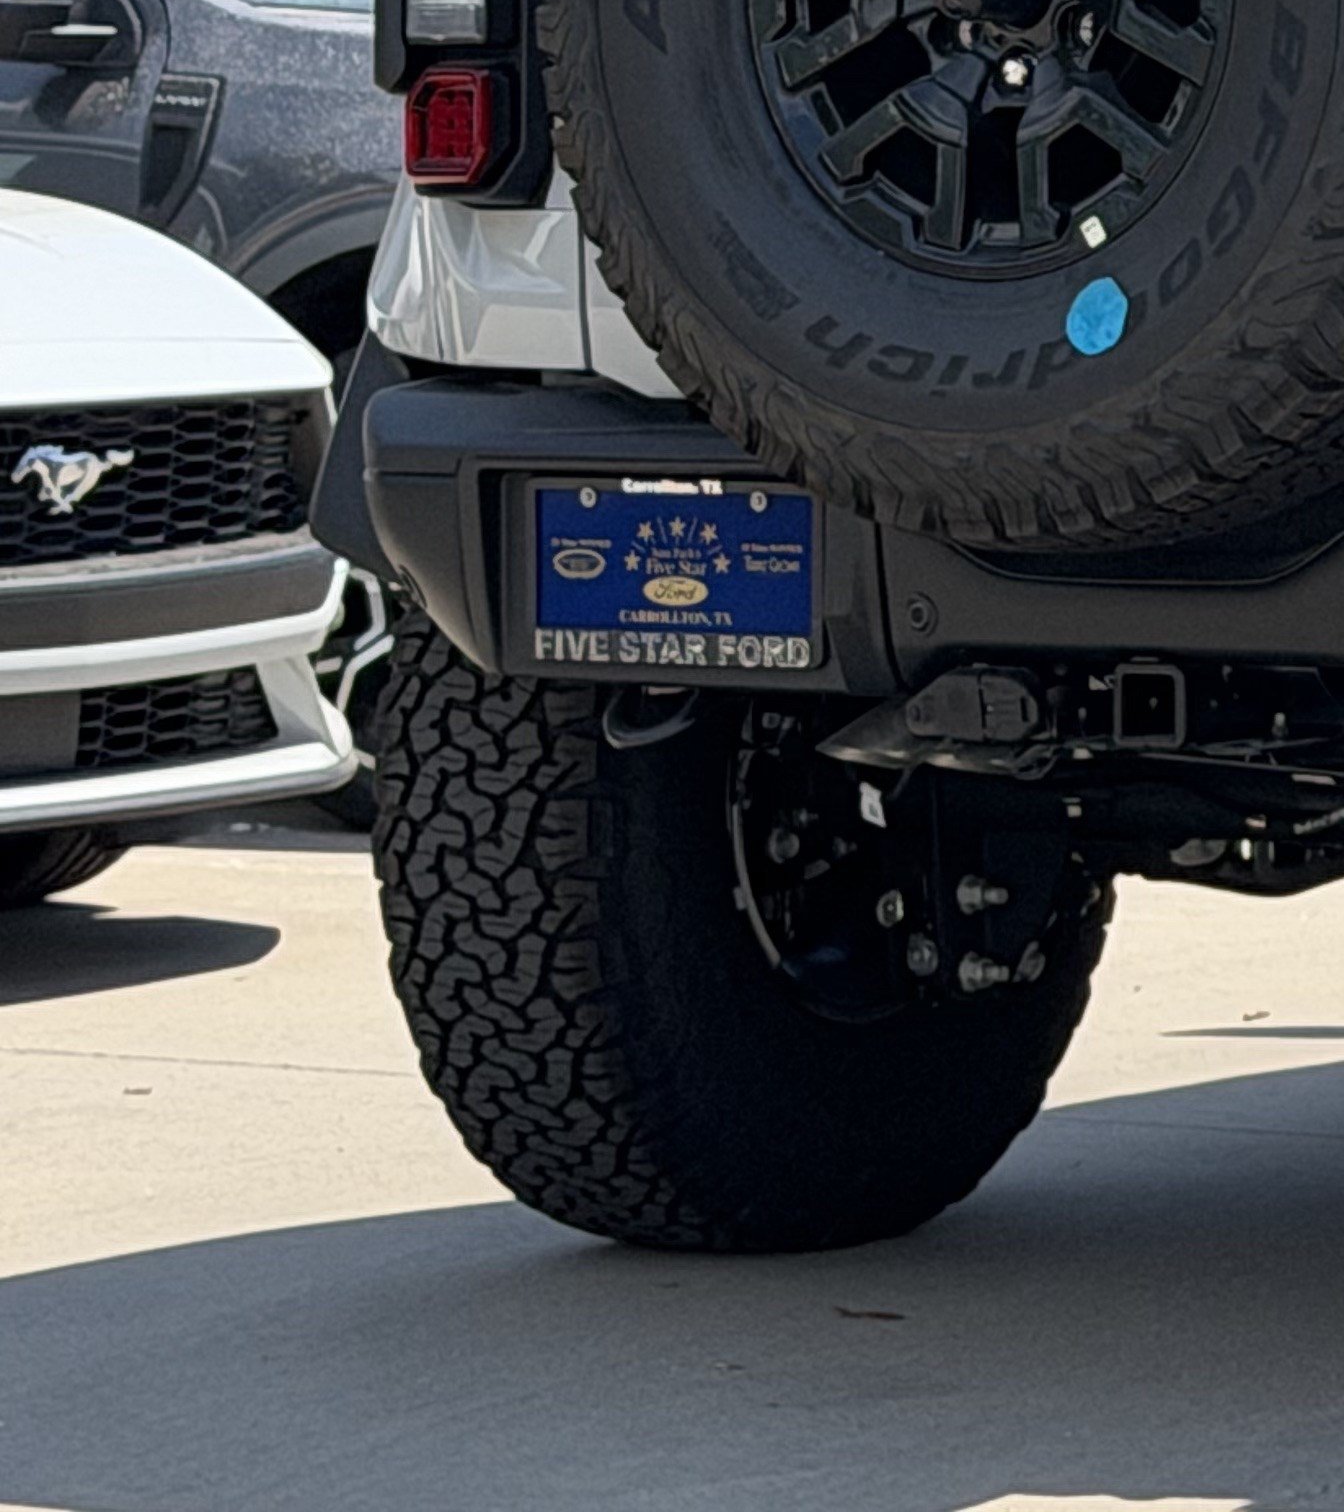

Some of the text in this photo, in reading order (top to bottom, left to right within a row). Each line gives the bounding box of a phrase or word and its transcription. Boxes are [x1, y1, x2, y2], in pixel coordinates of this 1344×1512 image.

[803, 0, 1310, 397] BFGodrich
[652, 579, 698, 601] Ford
[533, 628, 812, 670] FIVE STAR FORD
